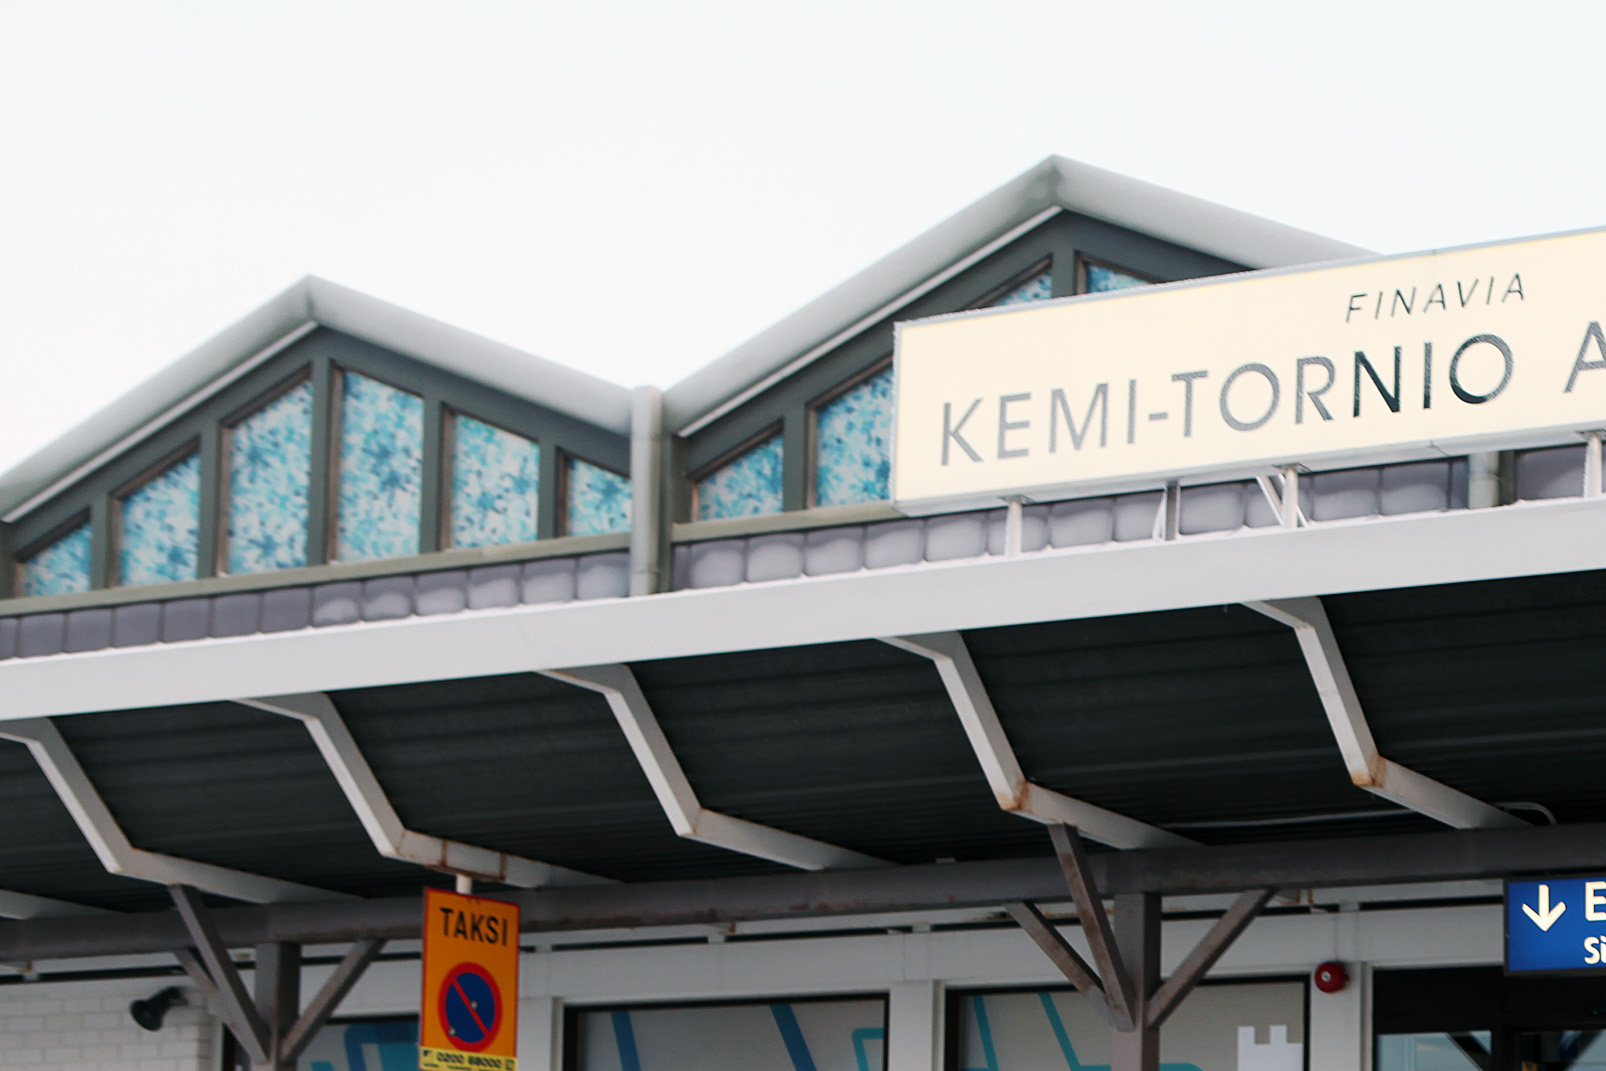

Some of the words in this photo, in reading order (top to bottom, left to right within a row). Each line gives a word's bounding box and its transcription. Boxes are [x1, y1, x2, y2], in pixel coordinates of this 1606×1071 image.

[1344, 272, 1525, 324] FINAVIA
[939, 333, 1515, 467] KEMI-TORNIO
[439, 906, 509, 947] TAKSI
